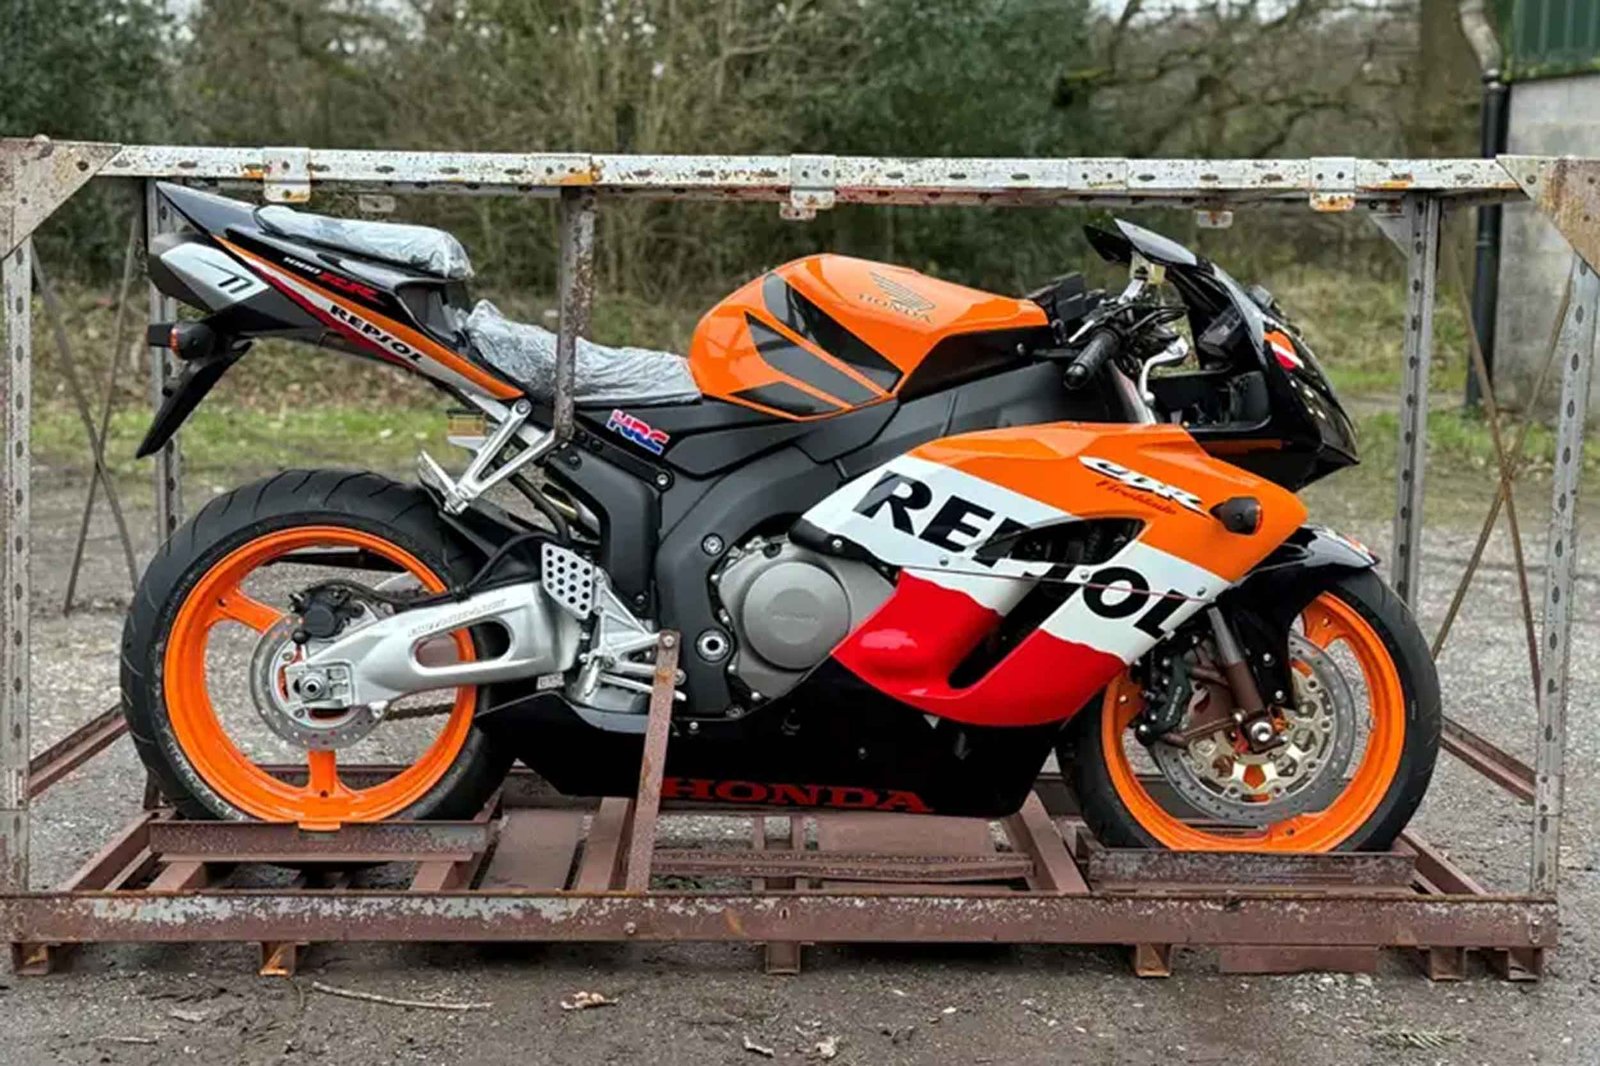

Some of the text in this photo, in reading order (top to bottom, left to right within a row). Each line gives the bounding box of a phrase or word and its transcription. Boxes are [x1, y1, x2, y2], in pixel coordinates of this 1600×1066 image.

[330, 305, 422, 361] REPSOL
[606, 409, 670, 455] HRC
[662, 777, 934, 813] HONDA
